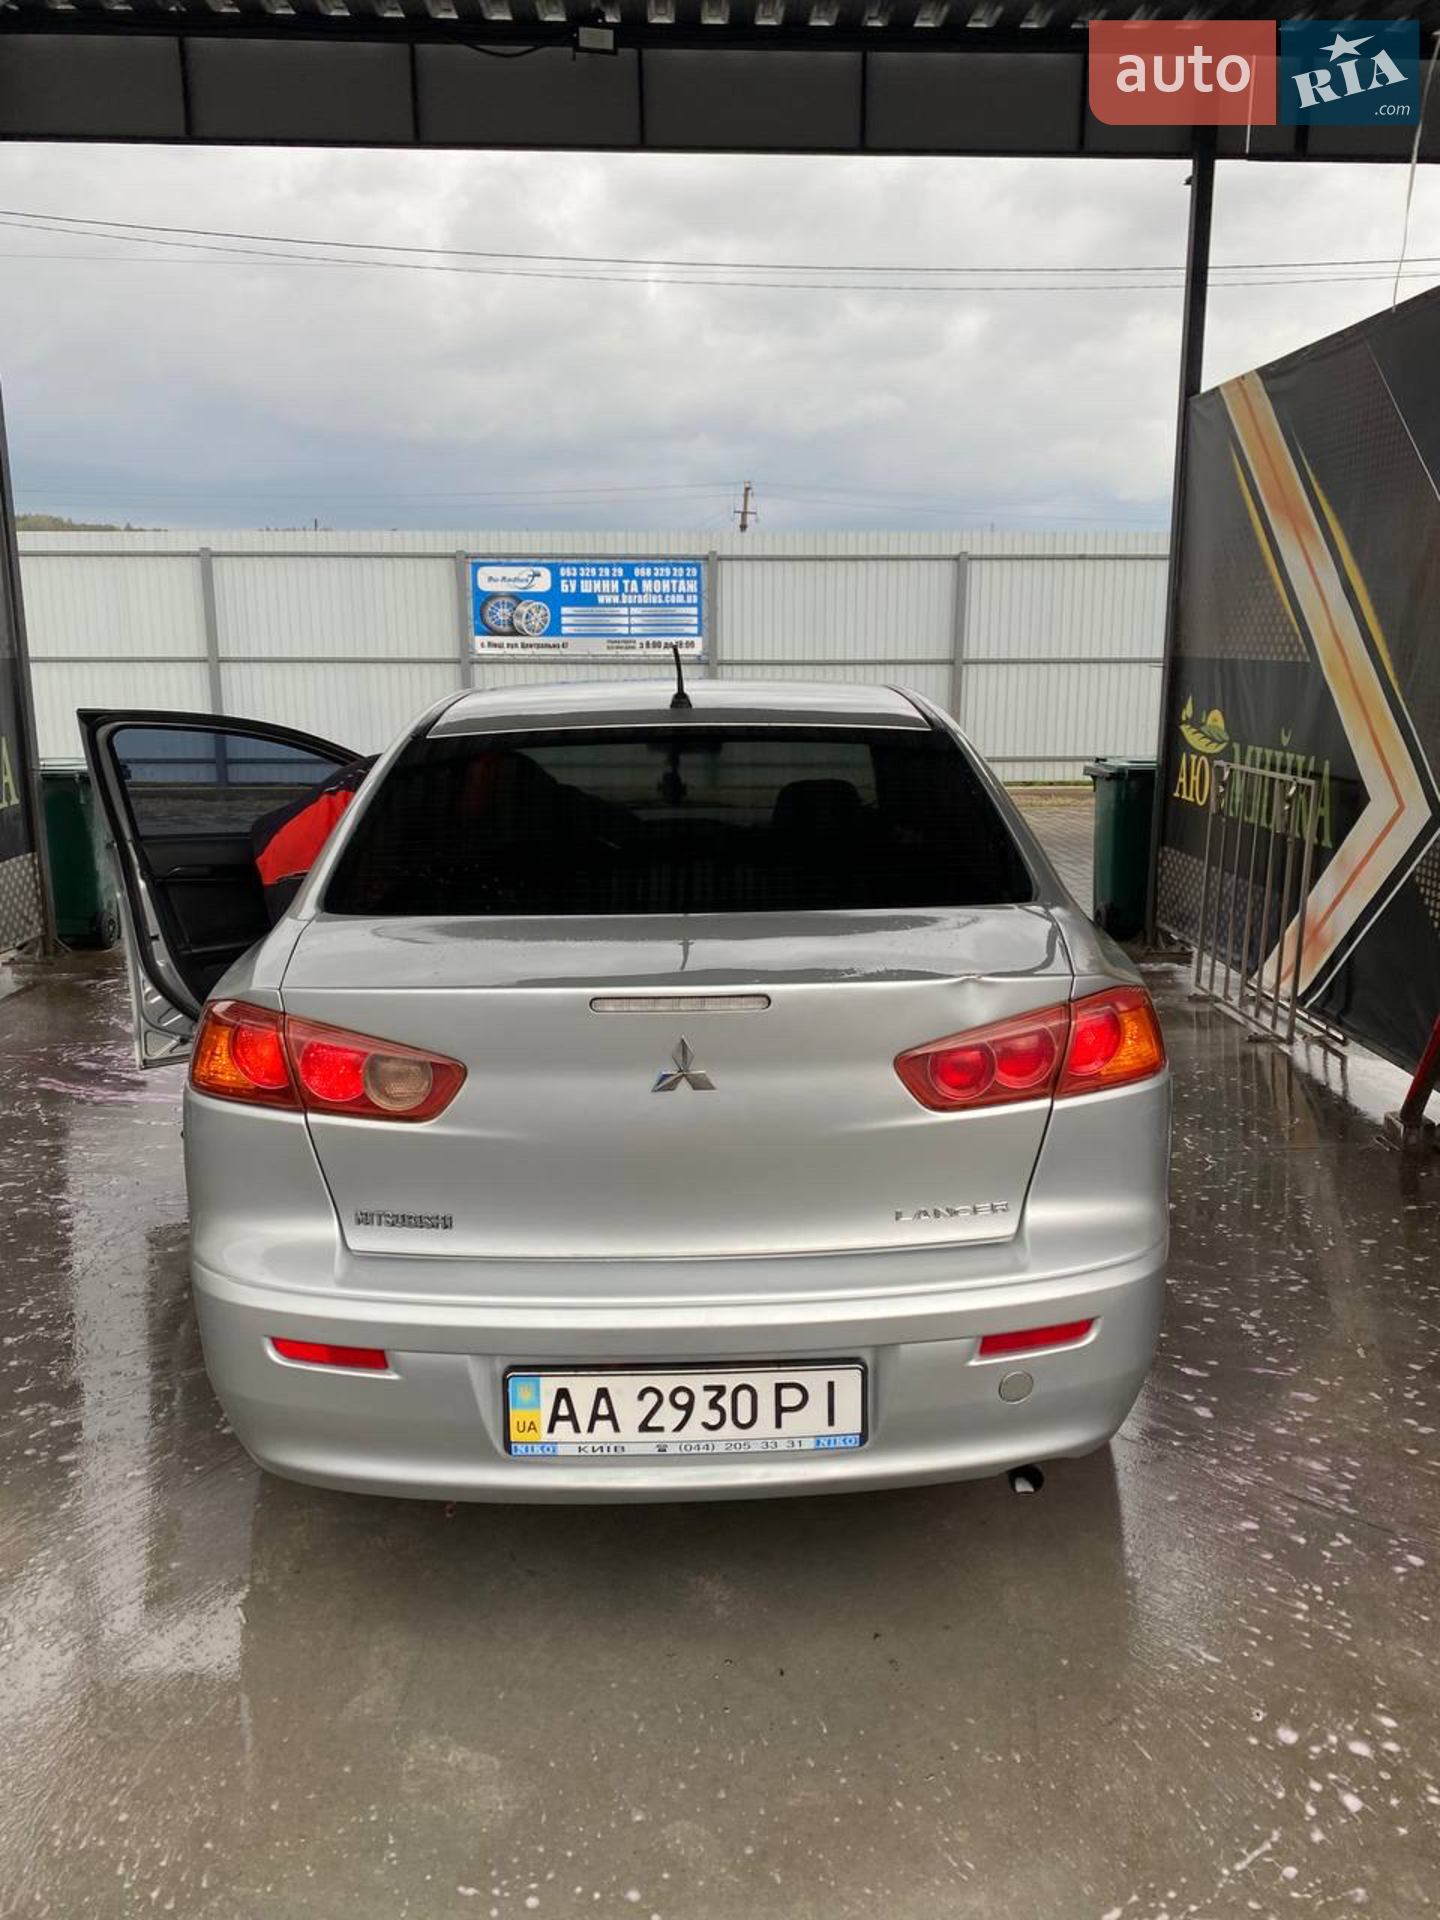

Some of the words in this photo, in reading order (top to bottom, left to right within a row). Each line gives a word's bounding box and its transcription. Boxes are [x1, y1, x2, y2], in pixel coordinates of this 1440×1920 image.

[560, 579, 577, 593] БУ
[580, 579, 619, 593] ШИНИ
[623, 579, 639, 593] ТА
[641, 579, 698, 593] МОНТАЖ
[894, 1201, 1008, 1221] LANCER
[547, 1387, 621, 1434] AA
[637, 1383, 758, 1433] 2930
[516, 1420, 538, 1434] UA
[678, 1441, 716, 1453] (044)
[724, 1441, 751, 1451] 205
[761, 1440, 779, 1450] 33
[786, 1439, 803, 1449] 31
